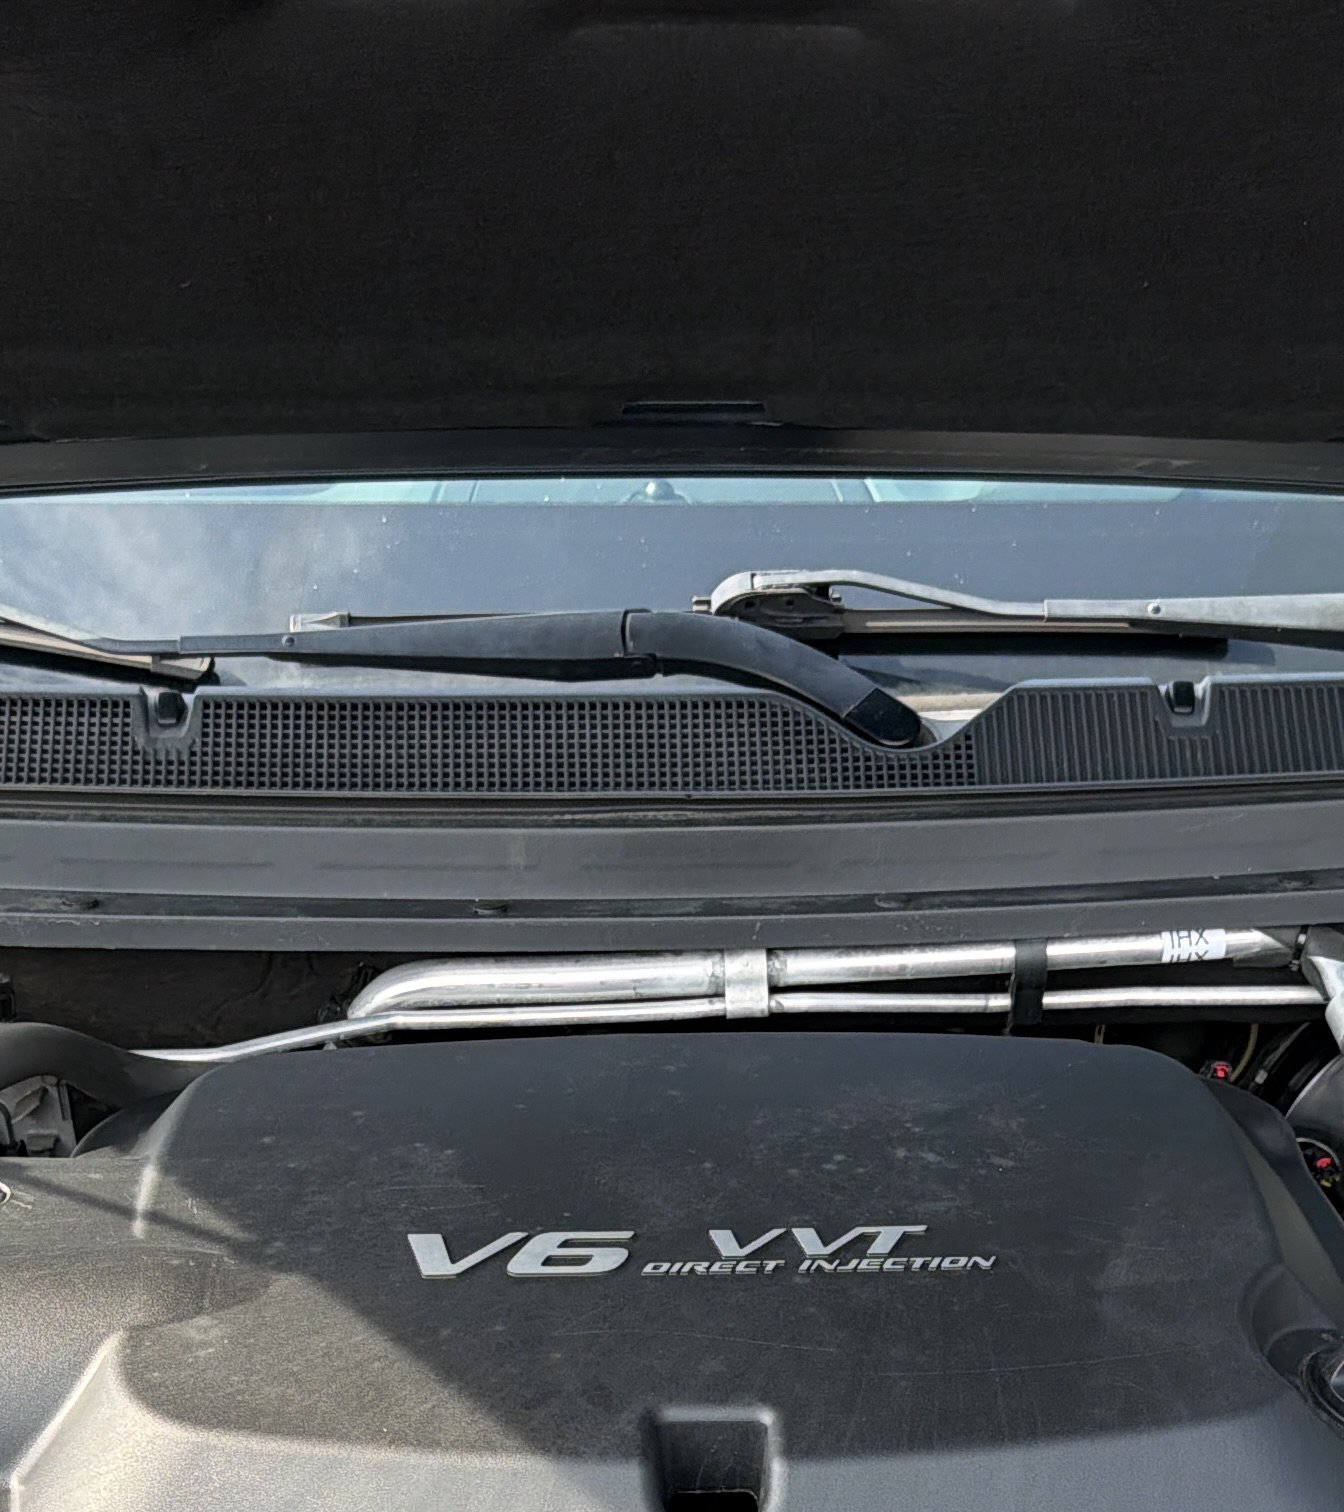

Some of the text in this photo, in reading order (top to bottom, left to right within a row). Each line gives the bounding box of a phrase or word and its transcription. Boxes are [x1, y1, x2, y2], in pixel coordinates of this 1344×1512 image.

[406, 1230, 636, 1279] V6
[707, 1225, 928, 1257] VVT
[641, 1255, 998, 1277] DIRECT INJECTION
